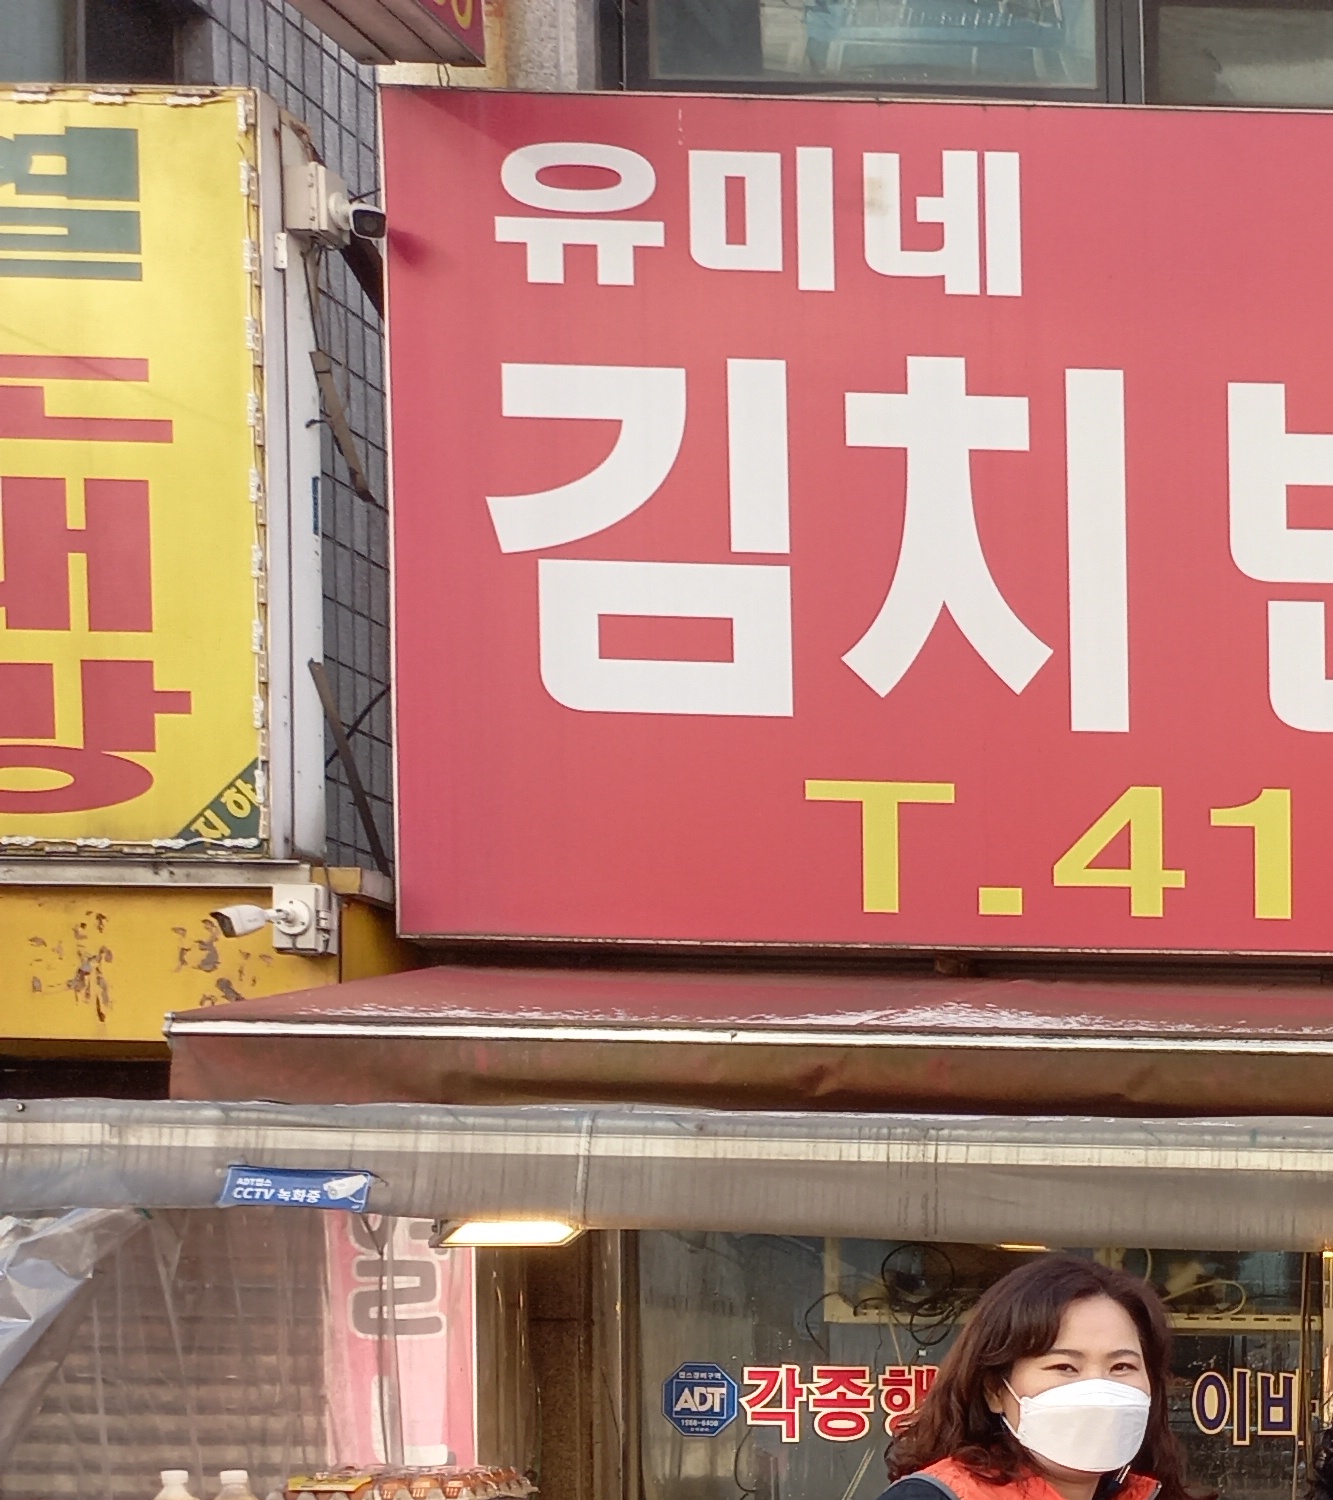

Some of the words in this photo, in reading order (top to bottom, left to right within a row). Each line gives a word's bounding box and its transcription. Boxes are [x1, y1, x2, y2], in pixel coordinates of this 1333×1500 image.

[494, 142, 1022, 297] 유미네
[486, 355, 1130, 733] 김치
[233, 1187, 275, 1200] CCTV
[277, 1188, 322, 1203] 녹화중
[674, 1386, 727, 1413] ADT
